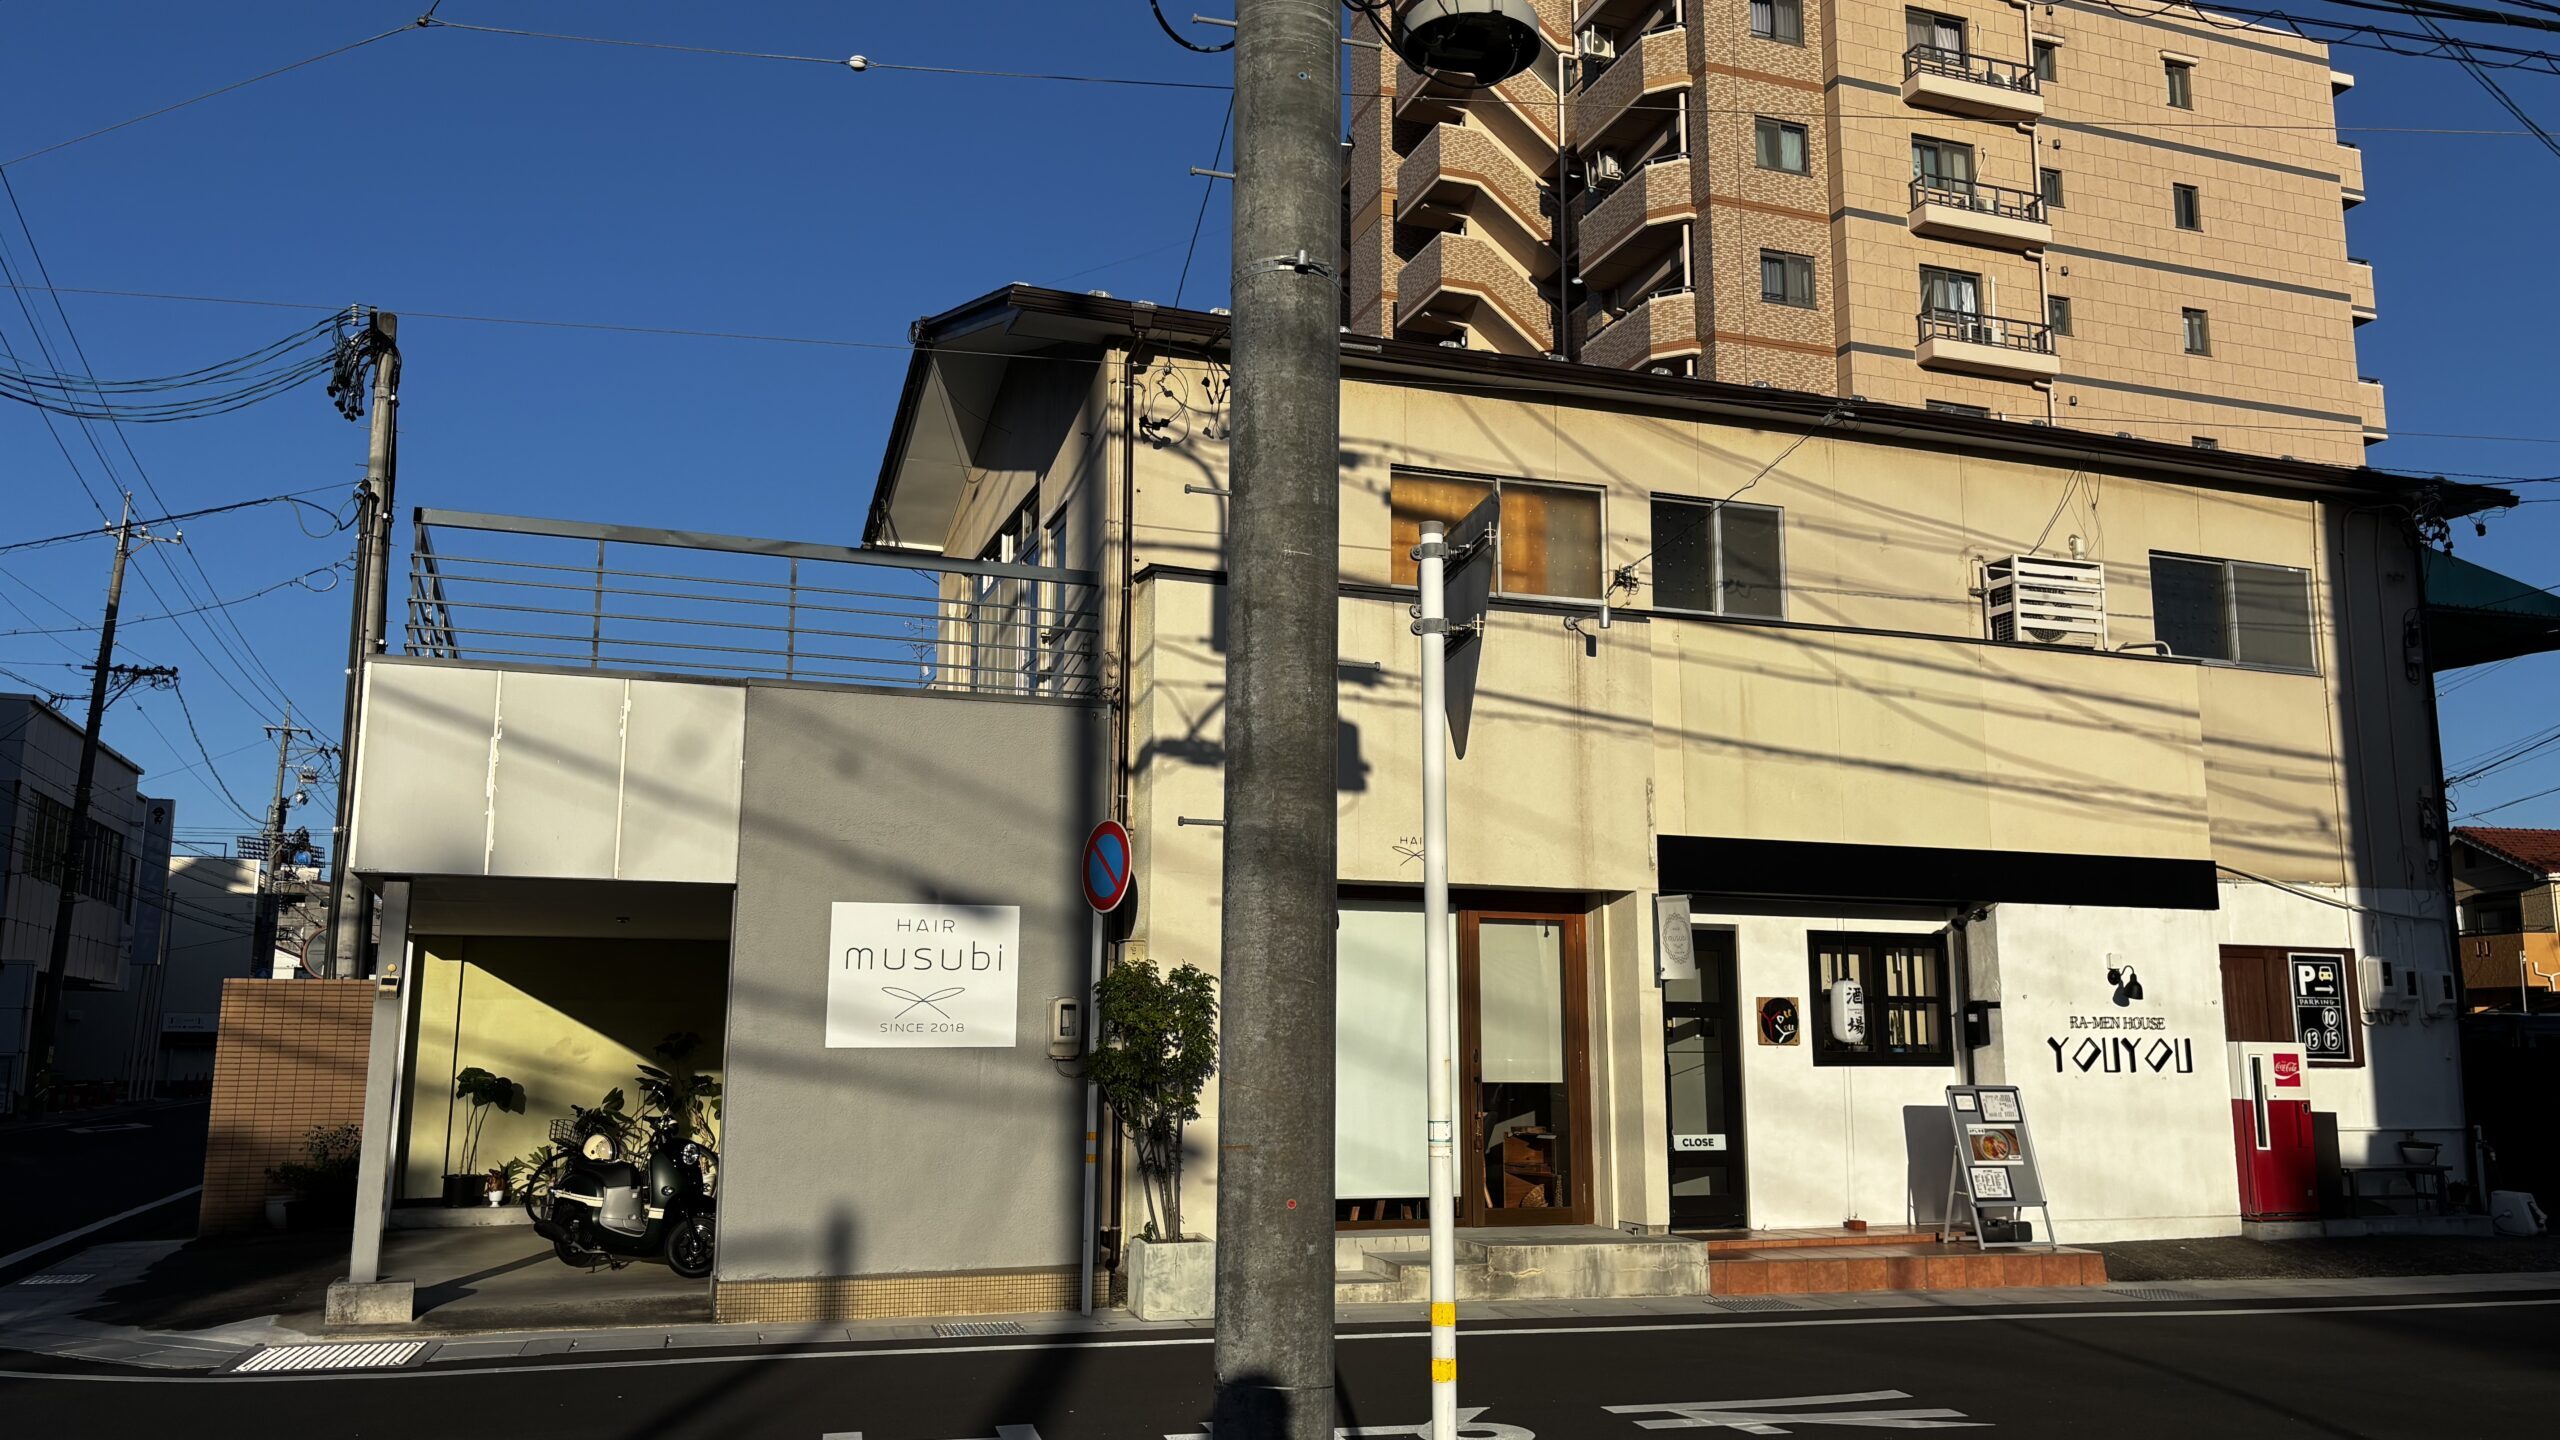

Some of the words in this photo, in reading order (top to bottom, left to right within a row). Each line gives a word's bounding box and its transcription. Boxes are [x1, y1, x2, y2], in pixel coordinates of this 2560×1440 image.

[1399, 836, 1423, 845] HAI
[897, 918, 956, 933] HAIR
[845, 940, 1003, 971] musubi
[2297, 965, 2316, 996] P
[2298, 998, 2336, 1006] PARKING
[1846, 986, 1864, 1035] 酒場
[2324, 1010, 2337, 1023] 10
[879, 1022, 925, 1033] SINCE
[930, 1022, 965, 1033] 2018
[2069, 1015, 2121, 1030] RA-MEN
[2122, 1016, 2166, 1031] HOUSE
[2306, 1031, 2319, 1048] 13
[2326, 1031, 2338, 1049] 15
[2046, 1036, 2193, 1073] YOUYOU
[1682, 1137, 1715, 1148] CLOSE
